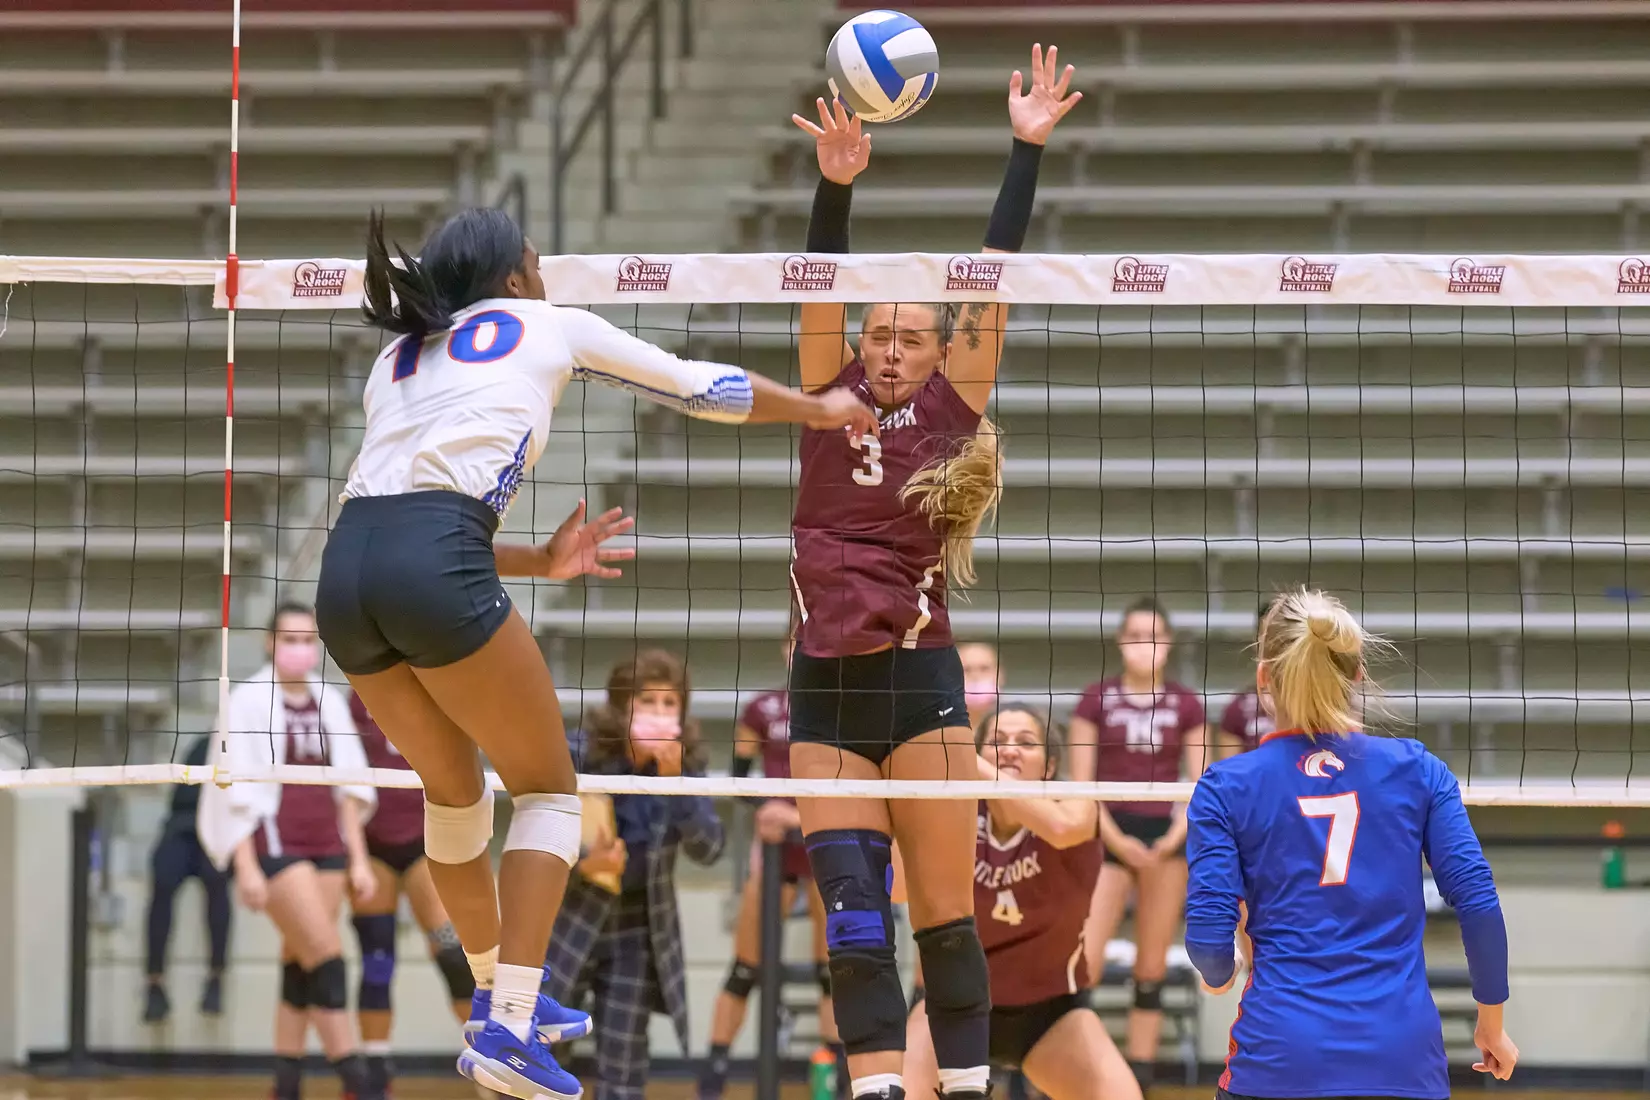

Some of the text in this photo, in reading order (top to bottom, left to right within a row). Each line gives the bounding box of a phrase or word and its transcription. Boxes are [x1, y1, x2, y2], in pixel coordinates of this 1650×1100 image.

[642, 265, 671, 273] LITTLE
[806, 264, 836, 272] LITTLE
[971, 264, 1001, 272] LITTLE
[1137, 265, 1168, 274] LITTLE
[1305, 265, 1336, 274] LITTLE
[1473, 267, 1504, 275] LITTLE
[317, 270, 345, 279] LITTLE
[640, 273, 668, 281] ROCK
[804, 272, 833, 280] ROCK
[969, 272, 999, 280] ROCK
[1136, 274, 1165, 282] ROCK
[1303, 273, 1333, 282] ROCK
[314, 279, 342, 287] ROCK
[1471, 275, 1501, 283] ROCK
[850, 434, 883, 486] 3
[1296, 790, 1360, 887] 7
[991, 889, 1023, 925] 4
